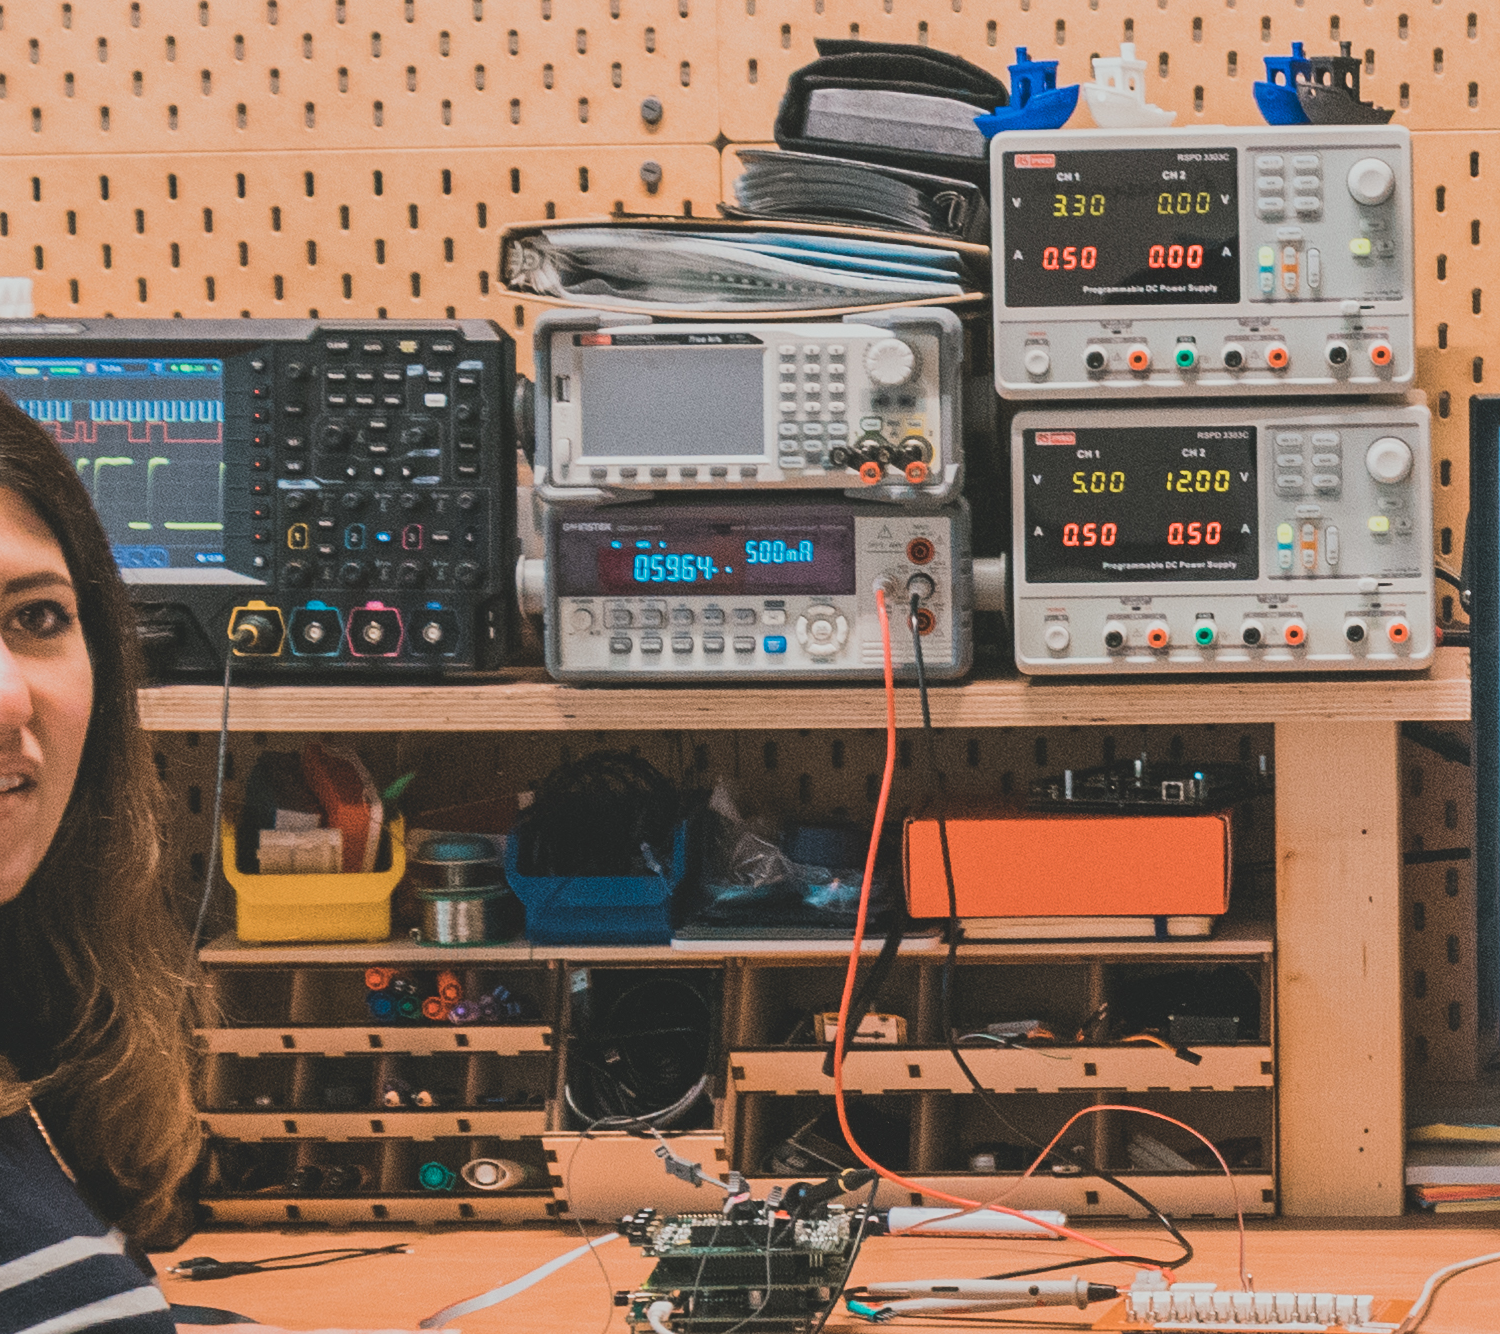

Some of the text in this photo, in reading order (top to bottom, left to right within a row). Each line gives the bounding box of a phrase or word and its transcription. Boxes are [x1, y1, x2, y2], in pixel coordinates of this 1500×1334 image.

[1056, 172, 1080, 182] CH 1
[1162, 170, 1186, 180] CH 2
[1012, 198, 1022, 208] V
[1220, 194, 1230, 205] V
[1013, 249, 1024, 260] A
[1221, 246, 1232, 257] A
[1083, 283, 1218, 294] Programmable DC Power Supply
[1076, 449, 1101, 459] CH 1
[1182, 448, 1206, 458] CH 2
[1032, 474, 1042, 485] V
[1072, 471, 1125, 493] 5.00
[1166, 470, 1230, 493] 12.00
[1239, 472, 1249, 482] V
[1033, 525, 1044, 536] A
[1240, 524, 1251, 534] A
[745, 540, 814, 564] 500mA
[1102, 560, 1237, 571] Programmable DC Power Supply
